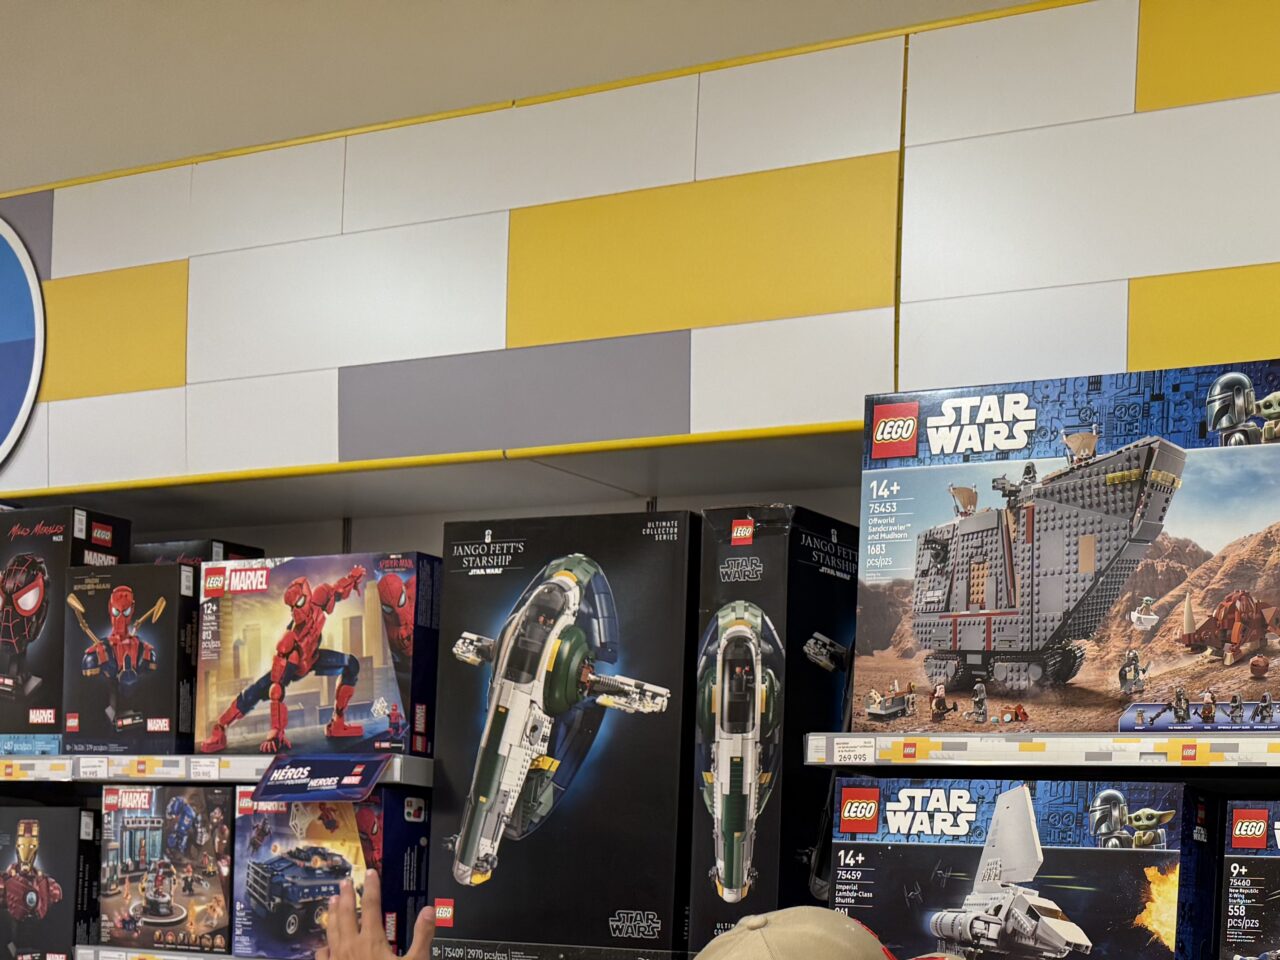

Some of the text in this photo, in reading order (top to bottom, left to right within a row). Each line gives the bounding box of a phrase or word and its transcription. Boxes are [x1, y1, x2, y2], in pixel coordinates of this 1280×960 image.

[928, 393, 1036, 426] STAR
[874, 418, 917, 444] LEGO
[927, 422, 1036, 455] WARS
[870, 480, 900, 499] 14+
[869, 503, 896, 513] 75453
[453, 542, 524, 556] JANGO FETT'S
[868, 544, 885, 554] 1683
[463, 555, 512, 567] STARSHIP
[867, 556, 892, 568] pcs/pzs
[231, 571, 267, 590] MARVEL
[203, 604, 217, 613] 12+
[29, 710, 55, 723] MARVEL
[147, 719, 169, 731] MARVEL
[271, 765, 311, 781] HÉROS
[308, 777, 339, 787] HEROES
[886, 788, 976, 812] STAR
[842, 801, 877, 821] LEGO
[886, 811, 976, 835] WARS
[1233, 821, 1265, 837] LEGO
[838, 850, 864, 867] 14+
[837, 870, 861, 879] 75459
[1230, 863, 1248, 878] 9+
[836, 890, 872, 898] Lambda-Class
[609, 910, 660, 925] STAR
[1228, 905, 1245, 916] 558
[610, 922, 660, 938] WARS
